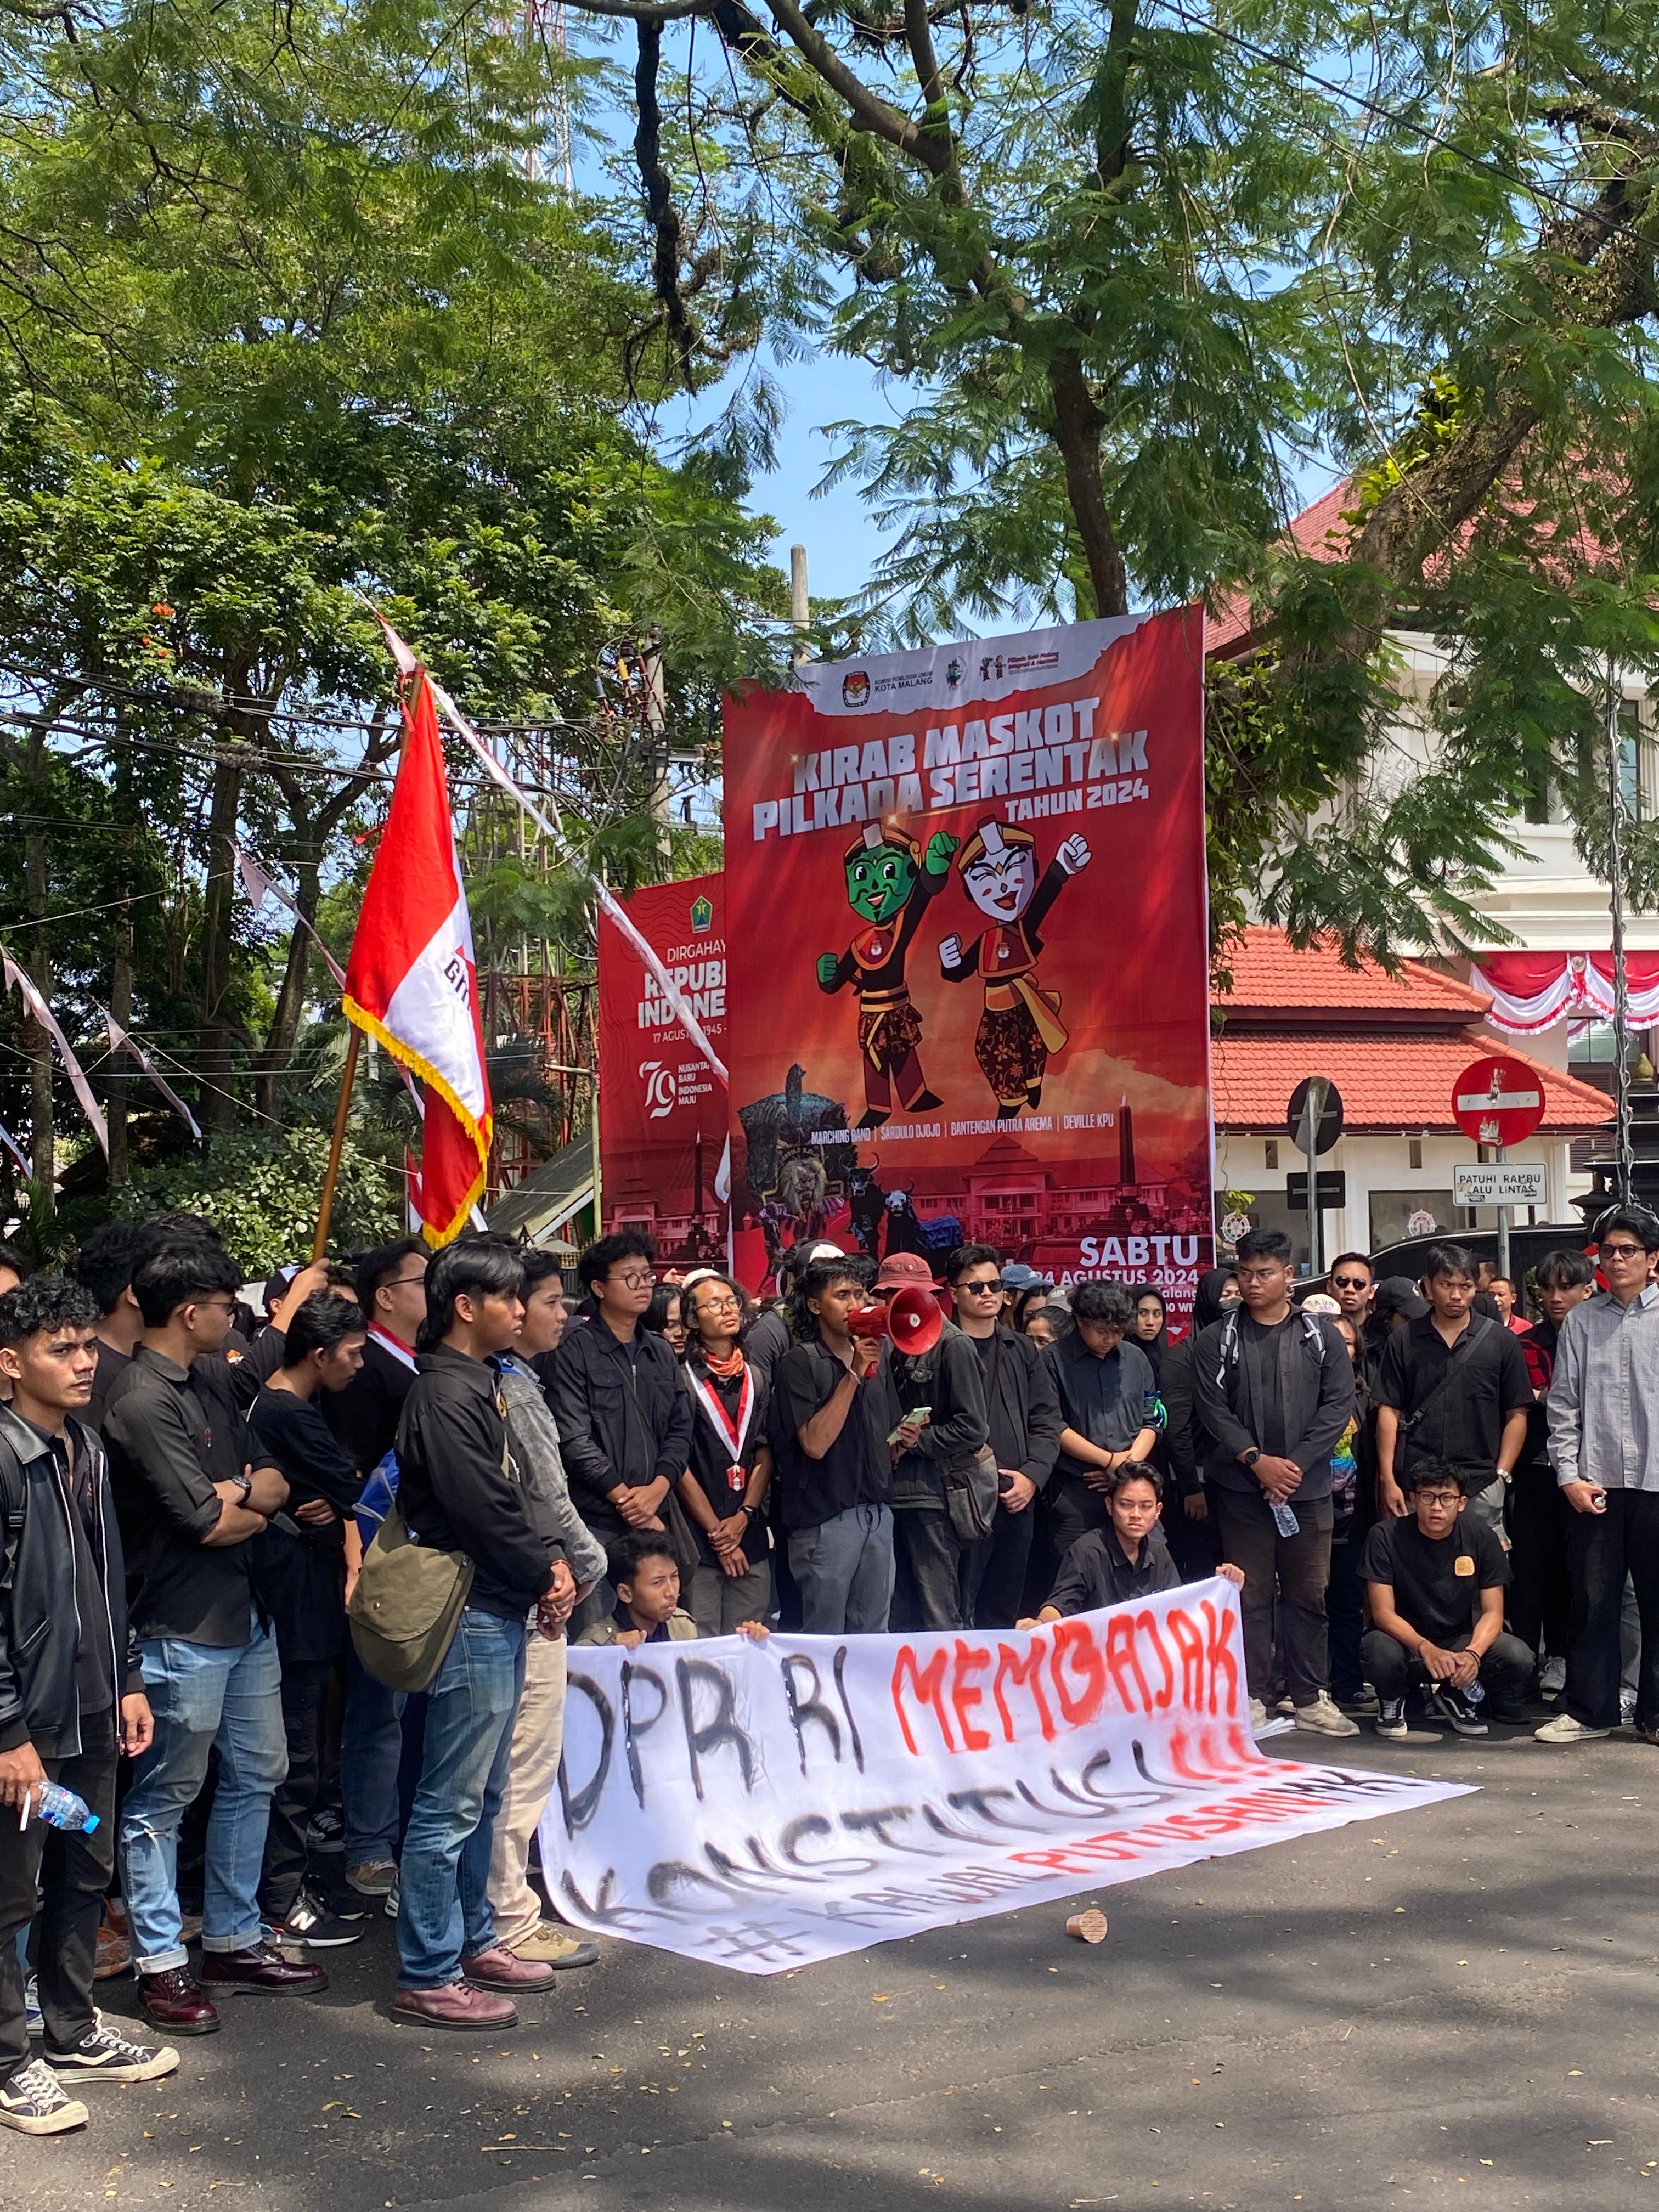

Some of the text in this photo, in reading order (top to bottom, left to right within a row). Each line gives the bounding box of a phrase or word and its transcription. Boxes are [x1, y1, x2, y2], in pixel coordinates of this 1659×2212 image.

[874, 676, 933, 693] KOTA MALANG
[794, 697, 1100, 794] KIRAB MASKOT
[753, 730, 1149, 842] PILKADA SERENTAK
[1005, 778, 1149, 822] TAHUN 2024
[653, 1032, 661, 1043] 17
[678, 1073, 696, 1084] BARU
[678, 1083, 713, 1096] INDONESIA
[678, 1094, 697, 1105] MAJU
[811, 1113, 1114, 1145] MARCHING BAND SARDULO DJOJO BANTENGAN PUTRA AREMA DEVILLE KPU
[1460, 1175, 1496, 1183] PATUHI
[1468, 1184, 1534, 1194] ALU LINTAS
[1080, 1235, 1198, 1267] SABTU
[1153, 1268, 1200, 1285] 2024
[1156, 1286, 1197, 1301] alang
[1177, 1302, 1195, 1312] WI
[558, 1600, 1237, 1841] DPR RI MEMBAJAK
